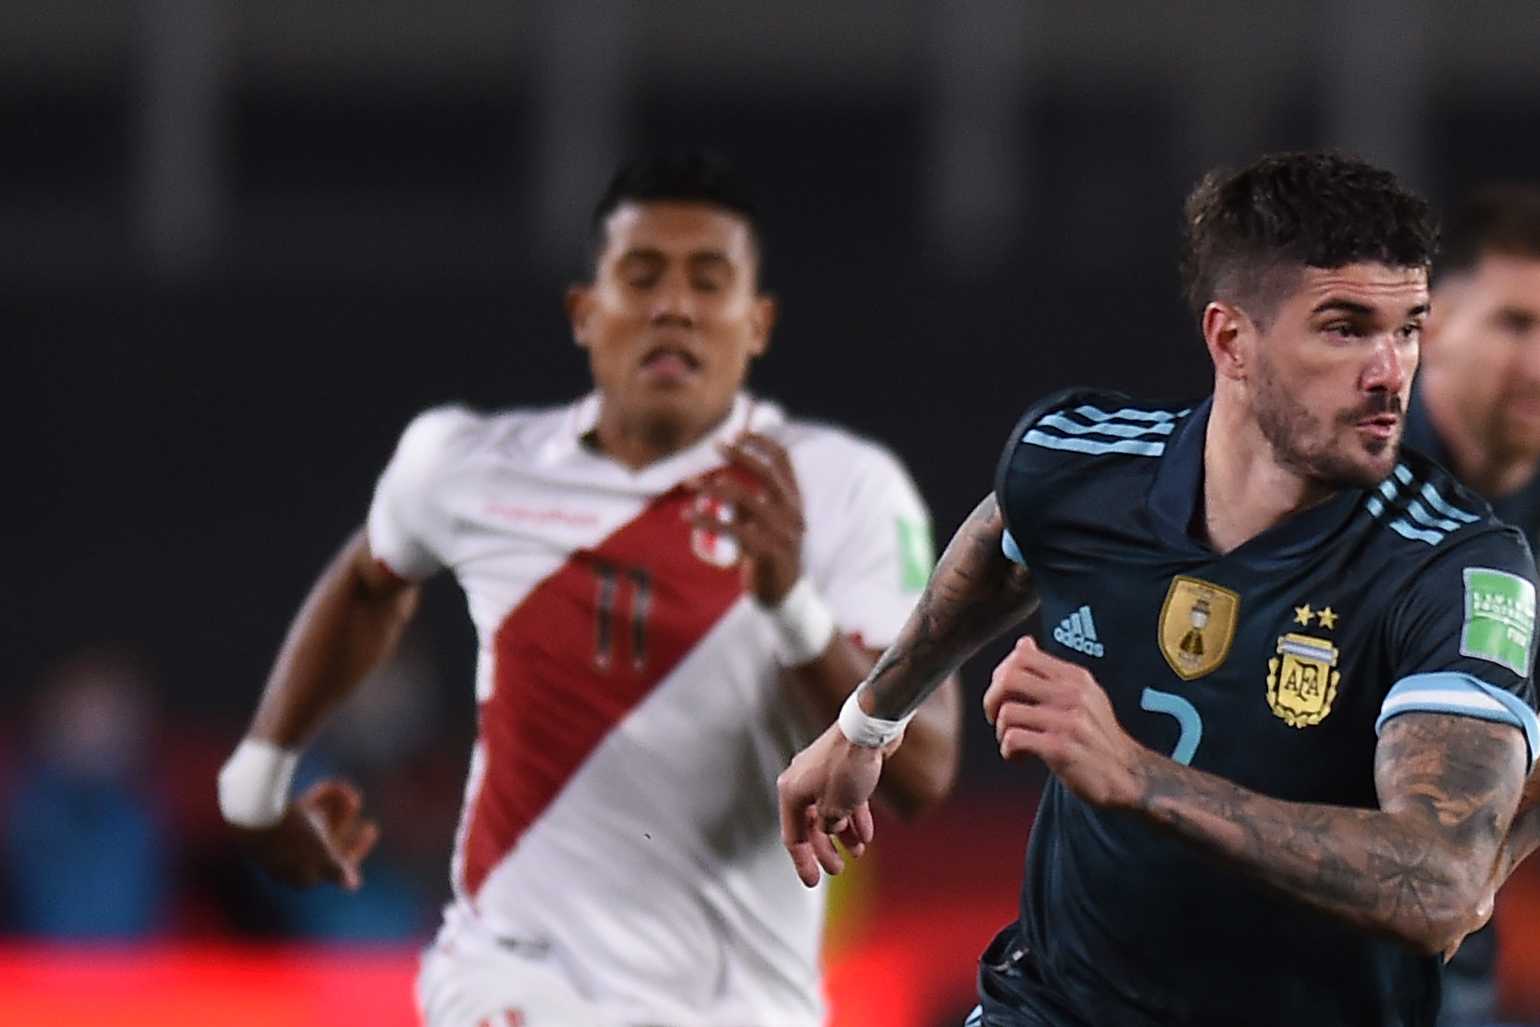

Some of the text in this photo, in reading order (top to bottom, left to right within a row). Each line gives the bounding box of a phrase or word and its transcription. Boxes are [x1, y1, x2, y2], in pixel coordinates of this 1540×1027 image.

[591, 560, 653, 672] 11
[1053, 626, 1104, 658] adidas
[1283, 658, 1320, 702] AFA
